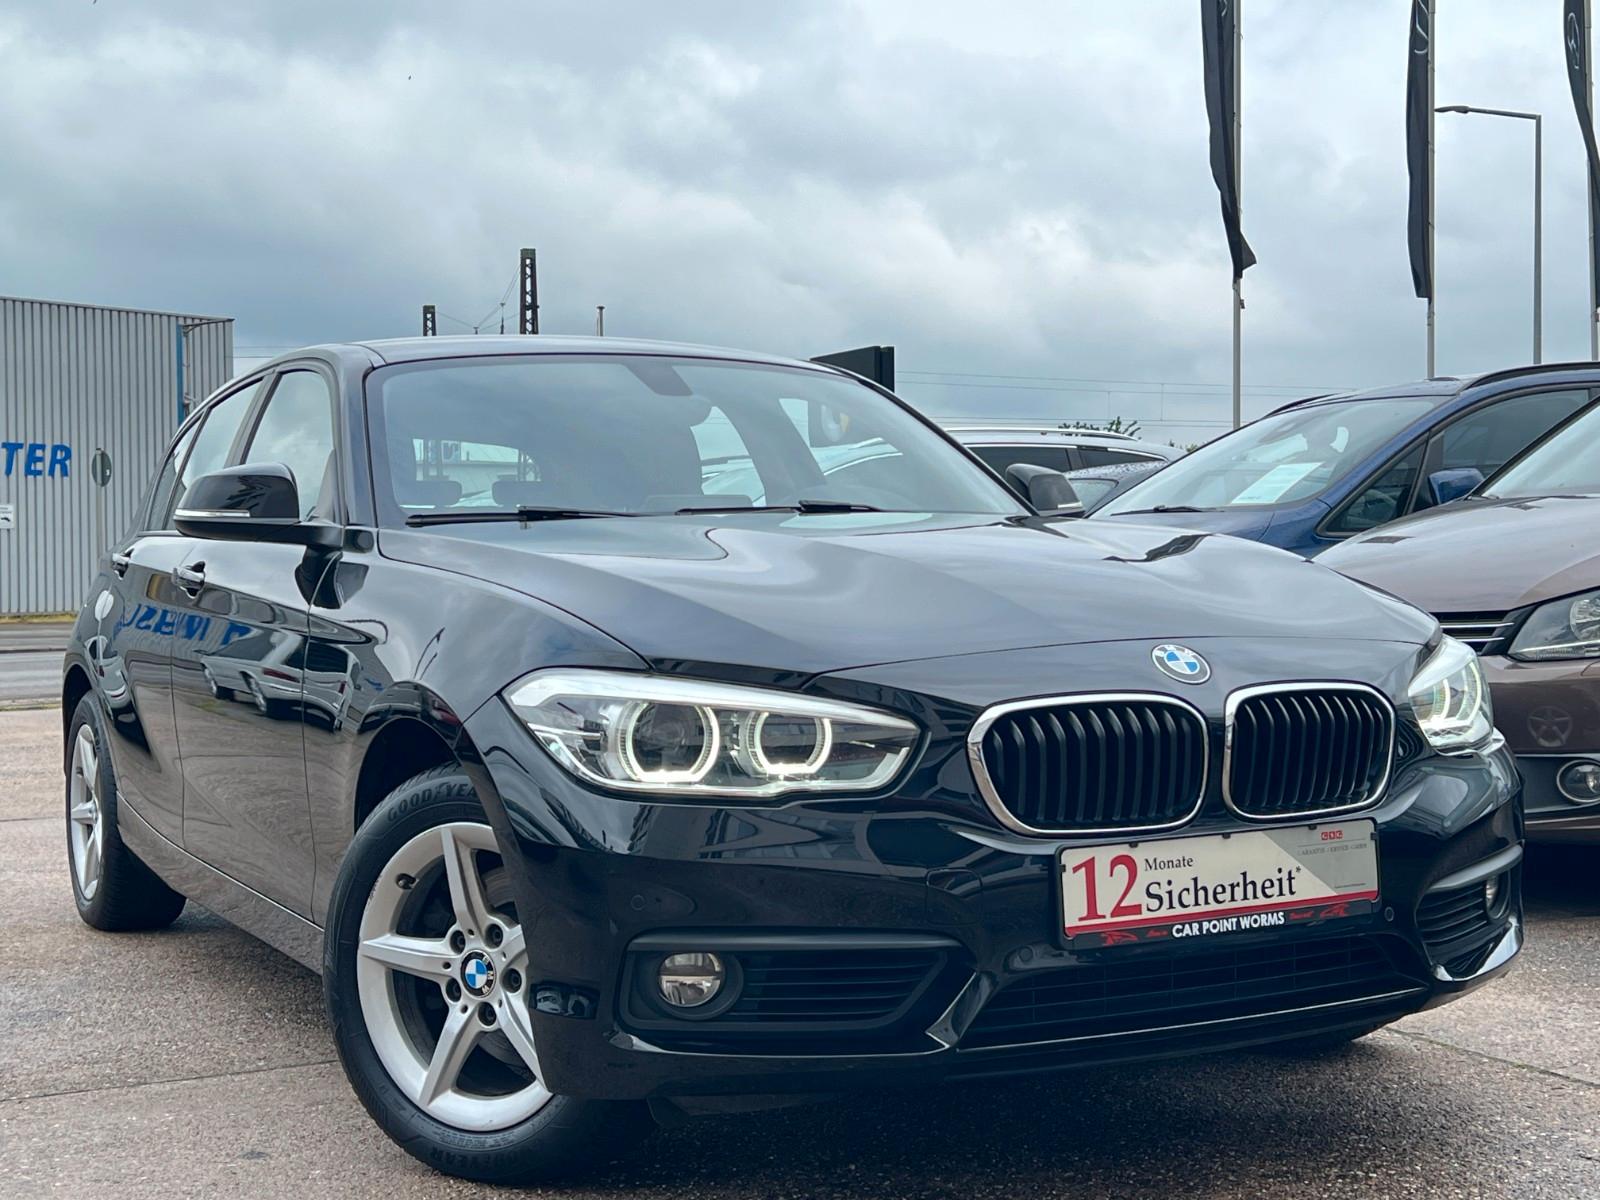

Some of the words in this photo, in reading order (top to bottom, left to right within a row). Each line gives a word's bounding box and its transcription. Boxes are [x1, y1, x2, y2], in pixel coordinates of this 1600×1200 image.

[1, 441, 72, 477] TER
[388, 782, 478, 822] GOODYEA
[1144, 855, 1194, 872] Monate
[1072, 854, 1142, 922] 12
[1172, 922, 1200, 938] CAR
[1202, 917, 1238, 935] POINT
[1239, 911, 1285, 930] WORMS
